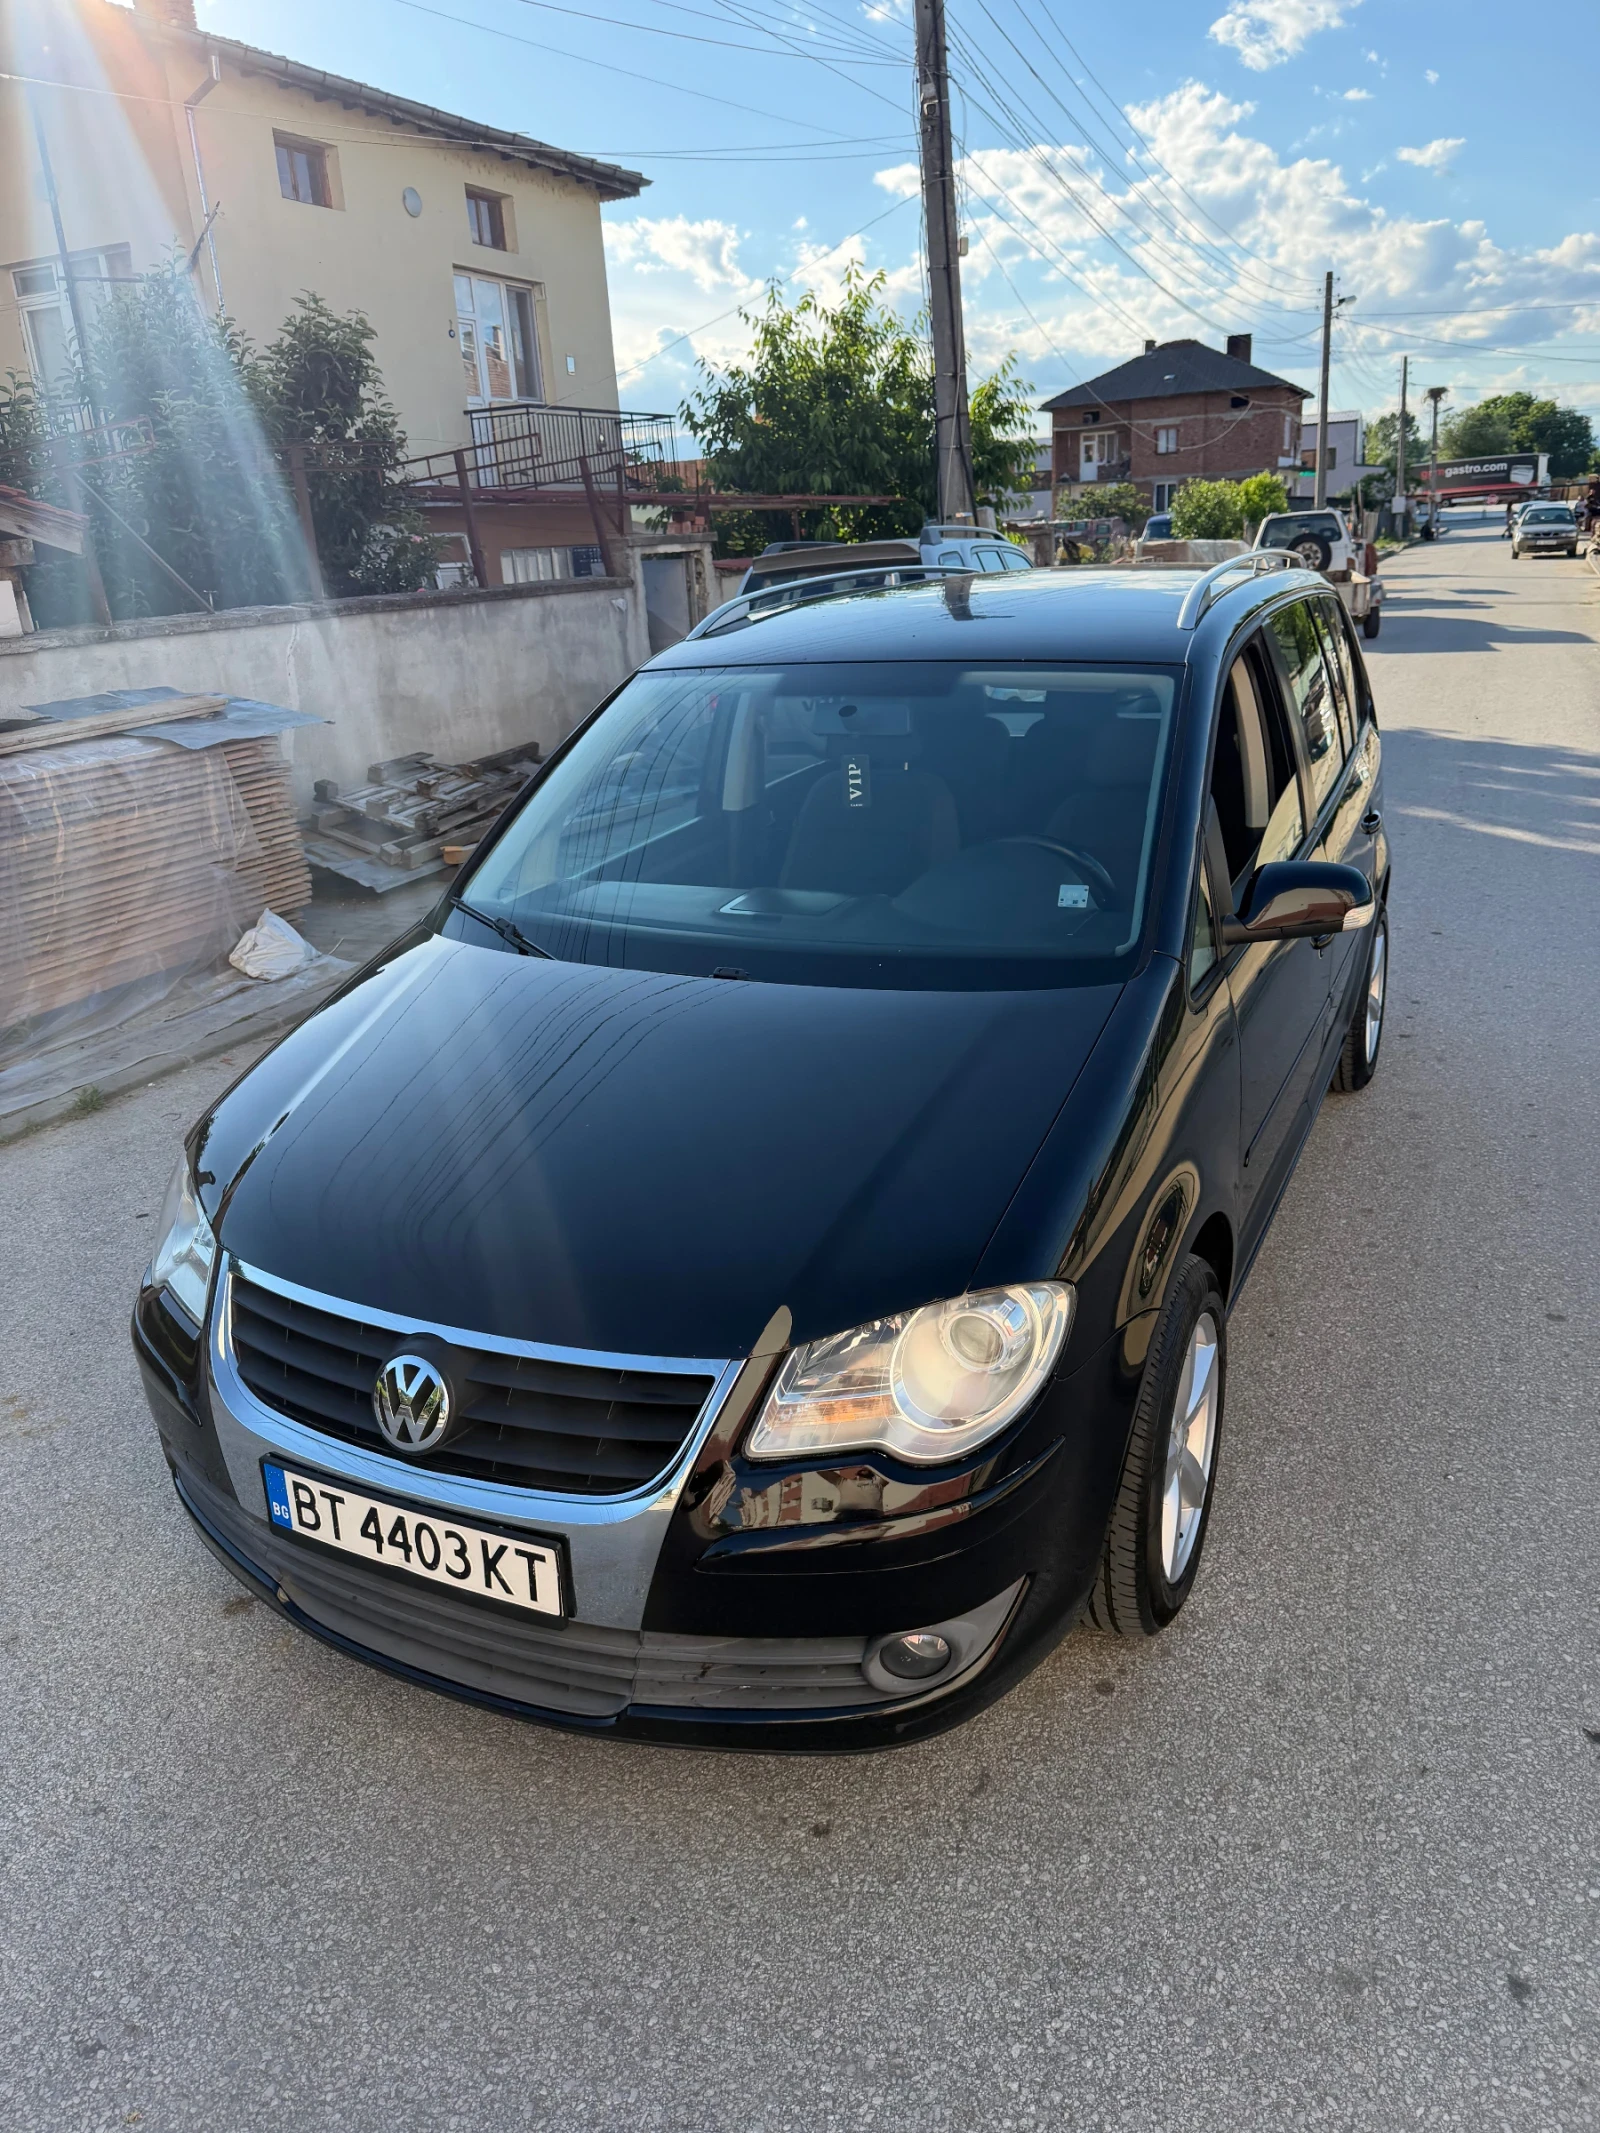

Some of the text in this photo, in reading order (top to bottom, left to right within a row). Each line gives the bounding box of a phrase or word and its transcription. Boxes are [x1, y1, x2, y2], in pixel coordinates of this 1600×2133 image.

[848, 763, 863, 801] VIP
[272, 1501, 290, 1520] BG
[292, 1480, 546, 1603] BT 4403 KT
